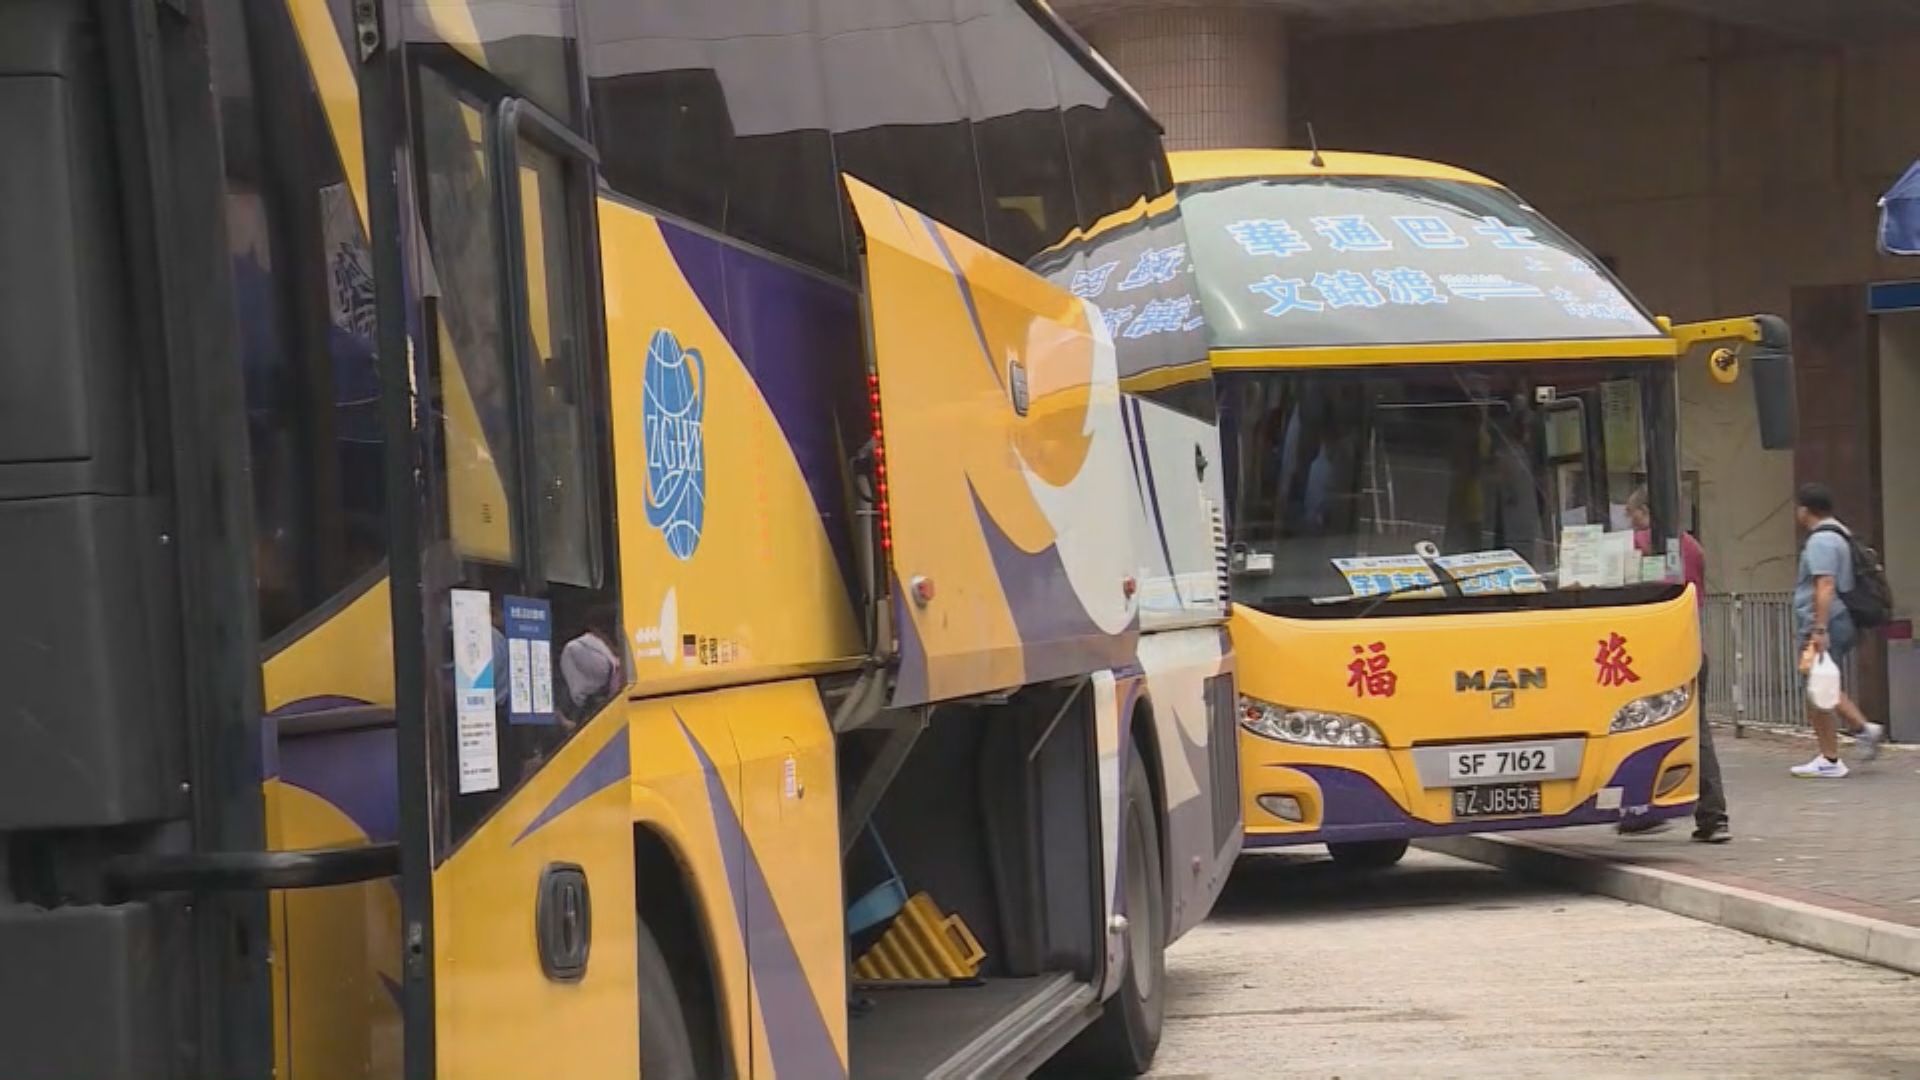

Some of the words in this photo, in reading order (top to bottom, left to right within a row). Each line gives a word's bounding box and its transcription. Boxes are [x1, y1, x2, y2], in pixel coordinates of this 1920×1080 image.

[1226, 214, 1545, 258] 華通巴士
[1248, 266, 1448, 318] 文錦渡
[1347, 641, 1398, 698] 福
[1454, 667, 1547, 693] MAN
[1594, 631, 1641, 687] 旅
[1458, 753, 1486, 775] SF
[1496, 750, 1546, 773] 7162
